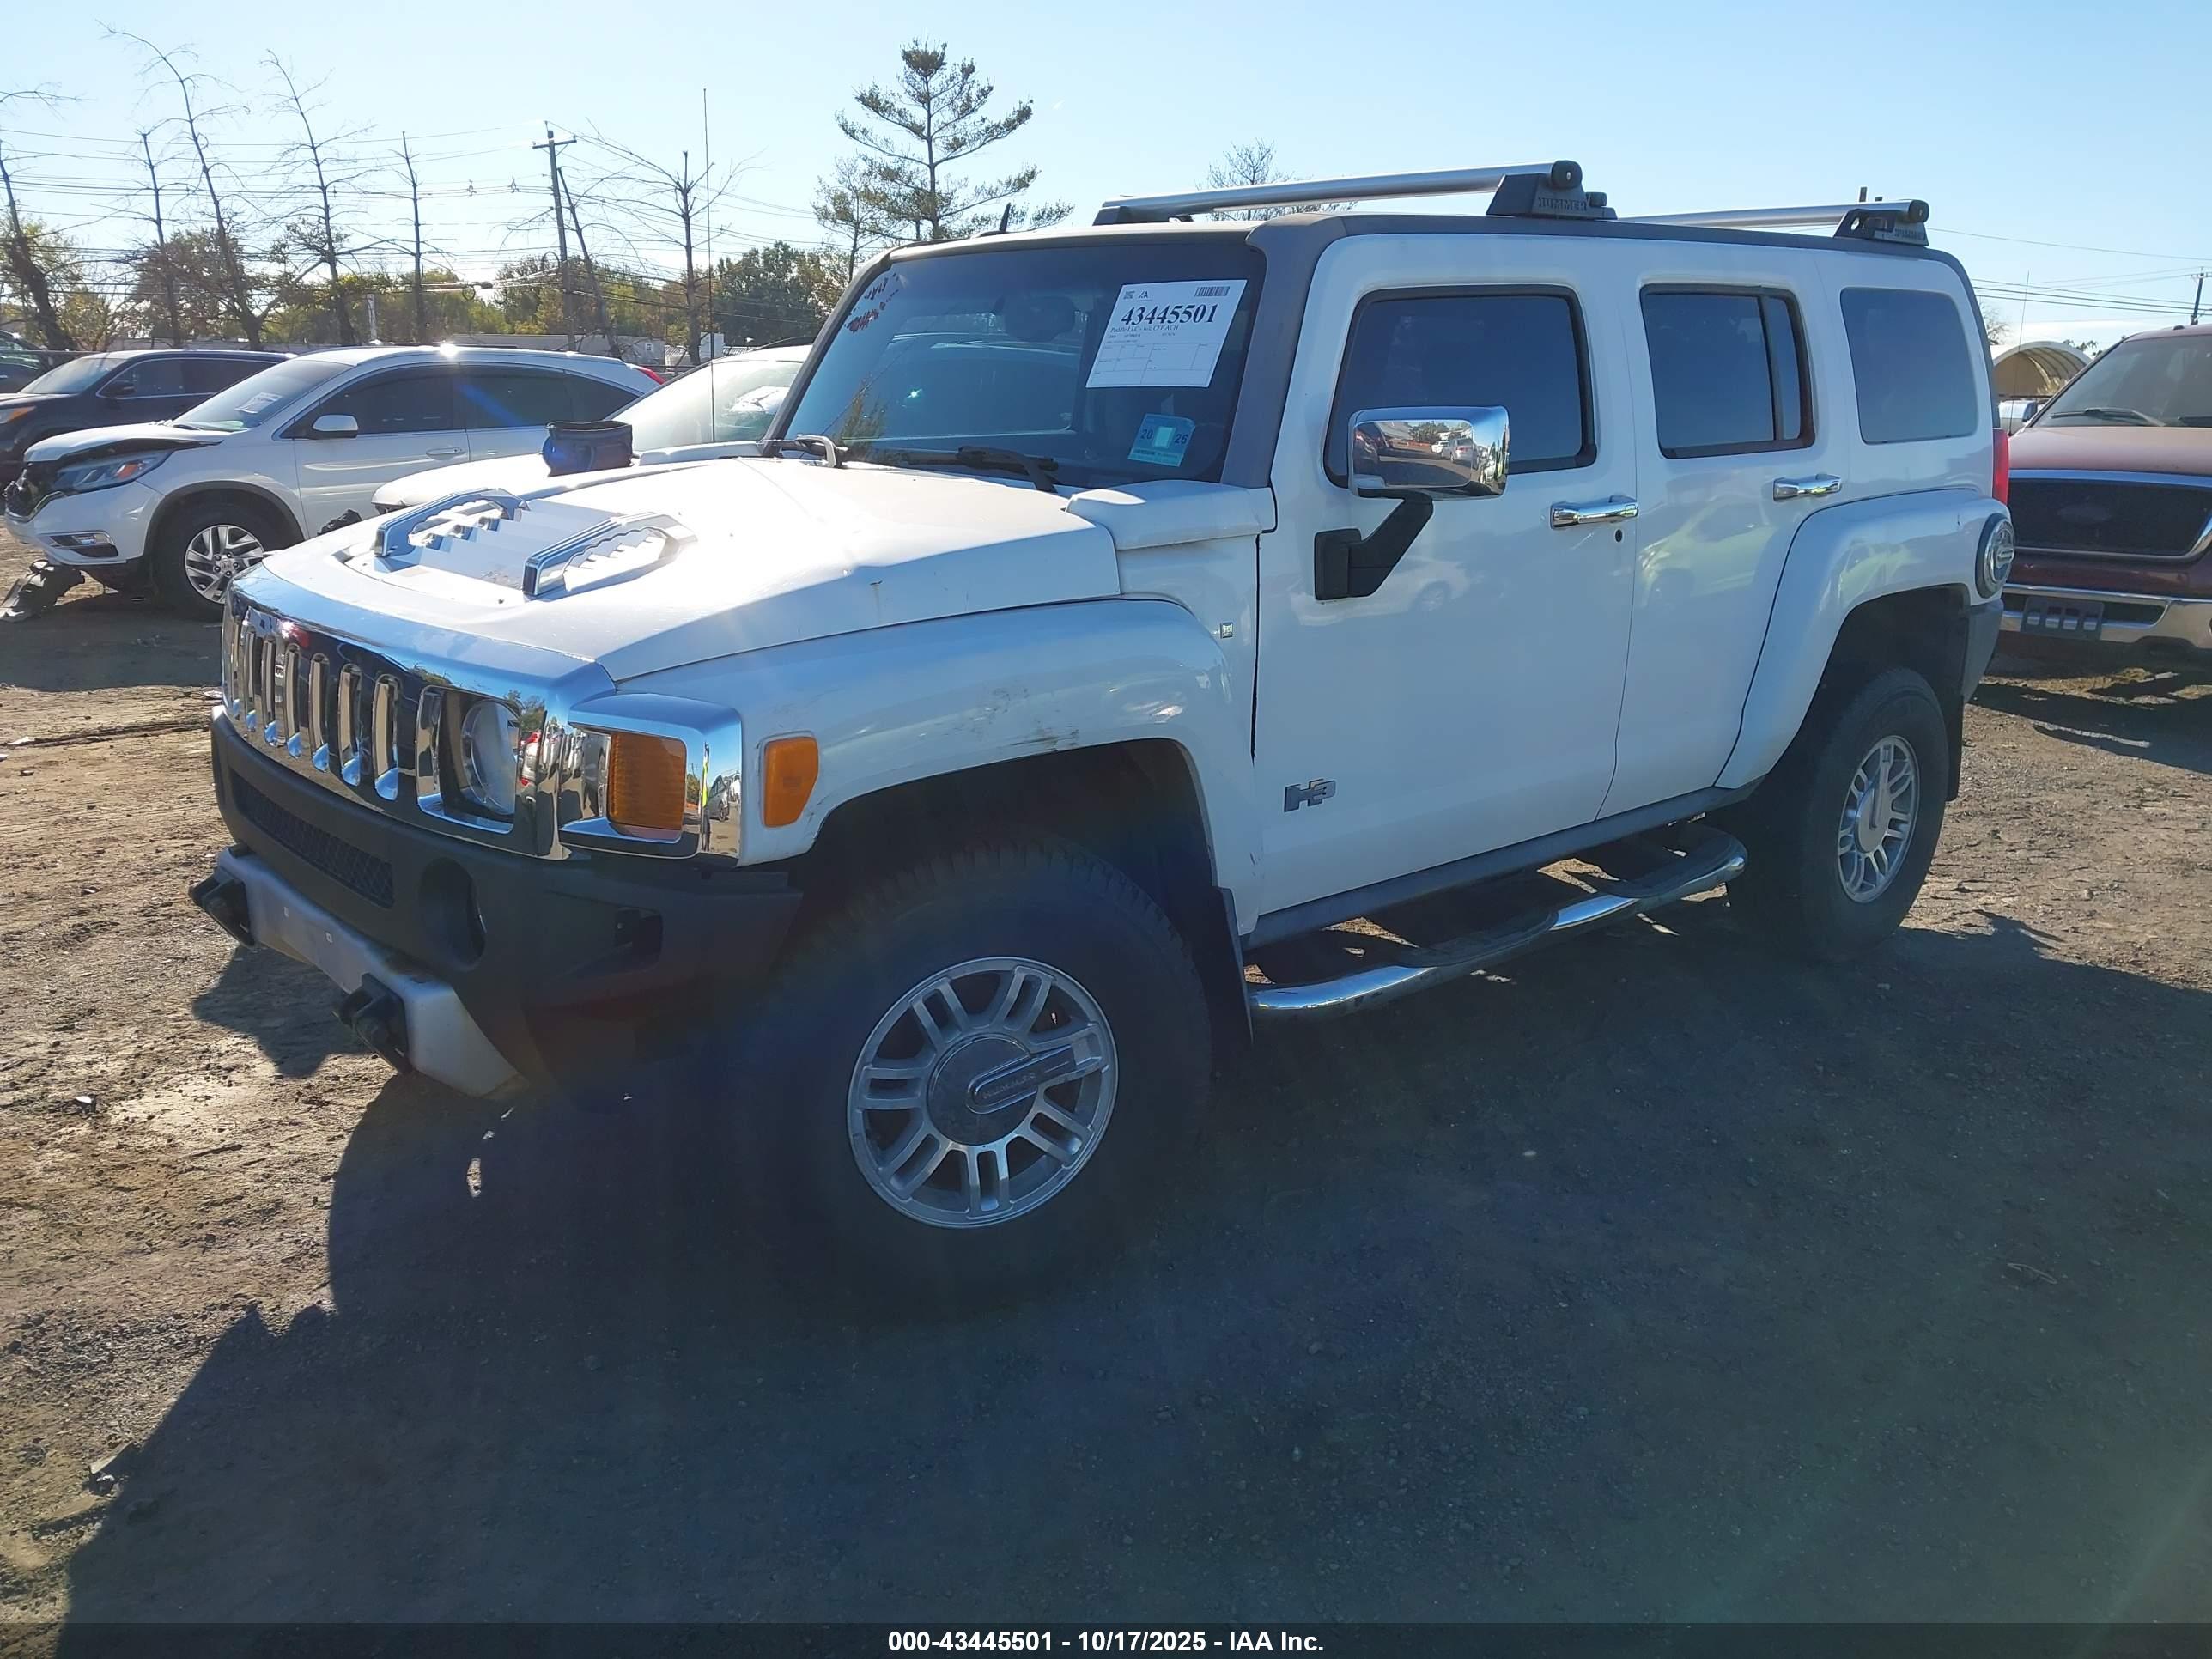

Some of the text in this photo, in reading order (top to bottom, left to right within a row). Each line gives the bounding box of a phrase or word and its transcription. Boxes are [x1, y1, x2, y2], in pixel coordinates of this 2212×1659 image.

[1121, 303, 1218, 325] 43445501
[1140, 428, 1154, 440] 20
[1174, 433, 1188, 444] 26
[1283, 778, 1336, 812] H3
